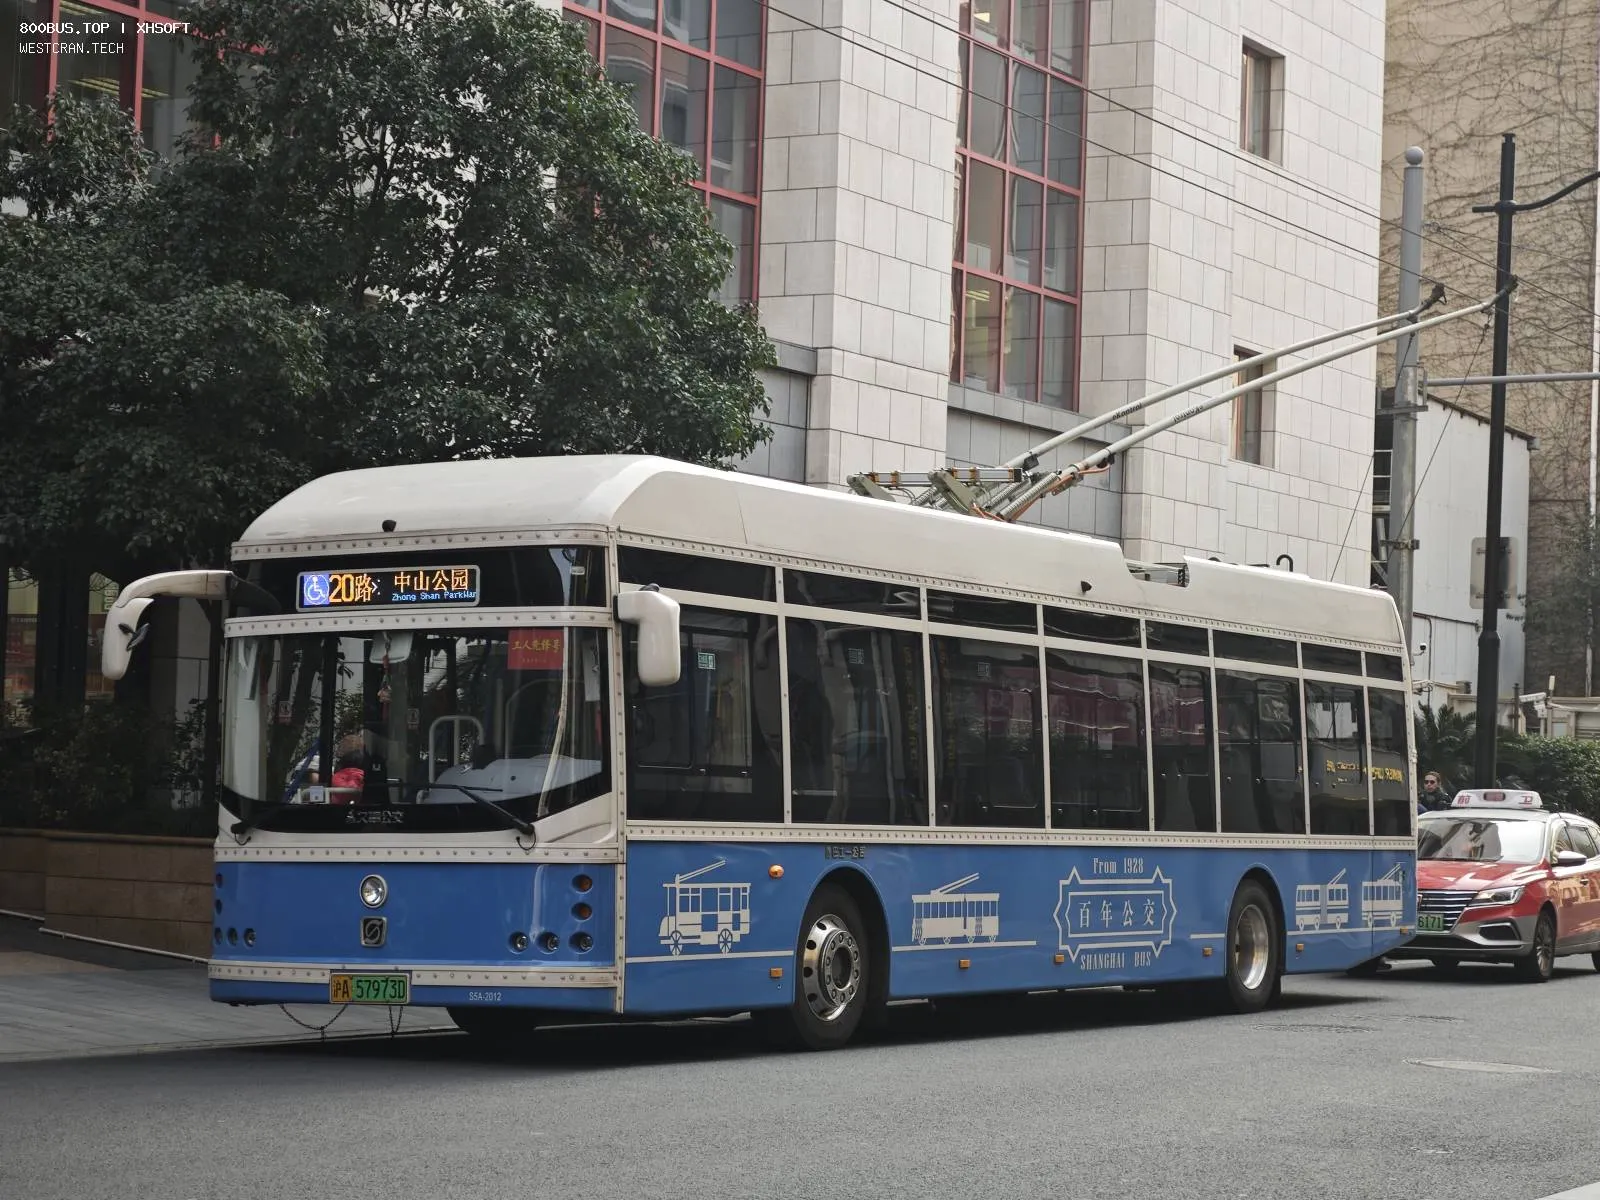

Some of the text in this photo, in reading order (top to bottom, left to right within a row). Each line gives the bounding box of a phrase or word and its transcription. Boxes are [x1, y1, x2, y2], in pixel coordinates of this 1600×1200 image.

[393, 568, 469, 593] 中山公园
[391, 593, 417, 602] Zhong
[420, 591, 441, 600] Shan
[1093, 857, 1144, 874] From 1928
[1079, 898, 1155, 929] 百年公交
[1080, 951, 1151, 971] SHANGHAI BUS
[468, 991, 502, 1001] S5A-2012
